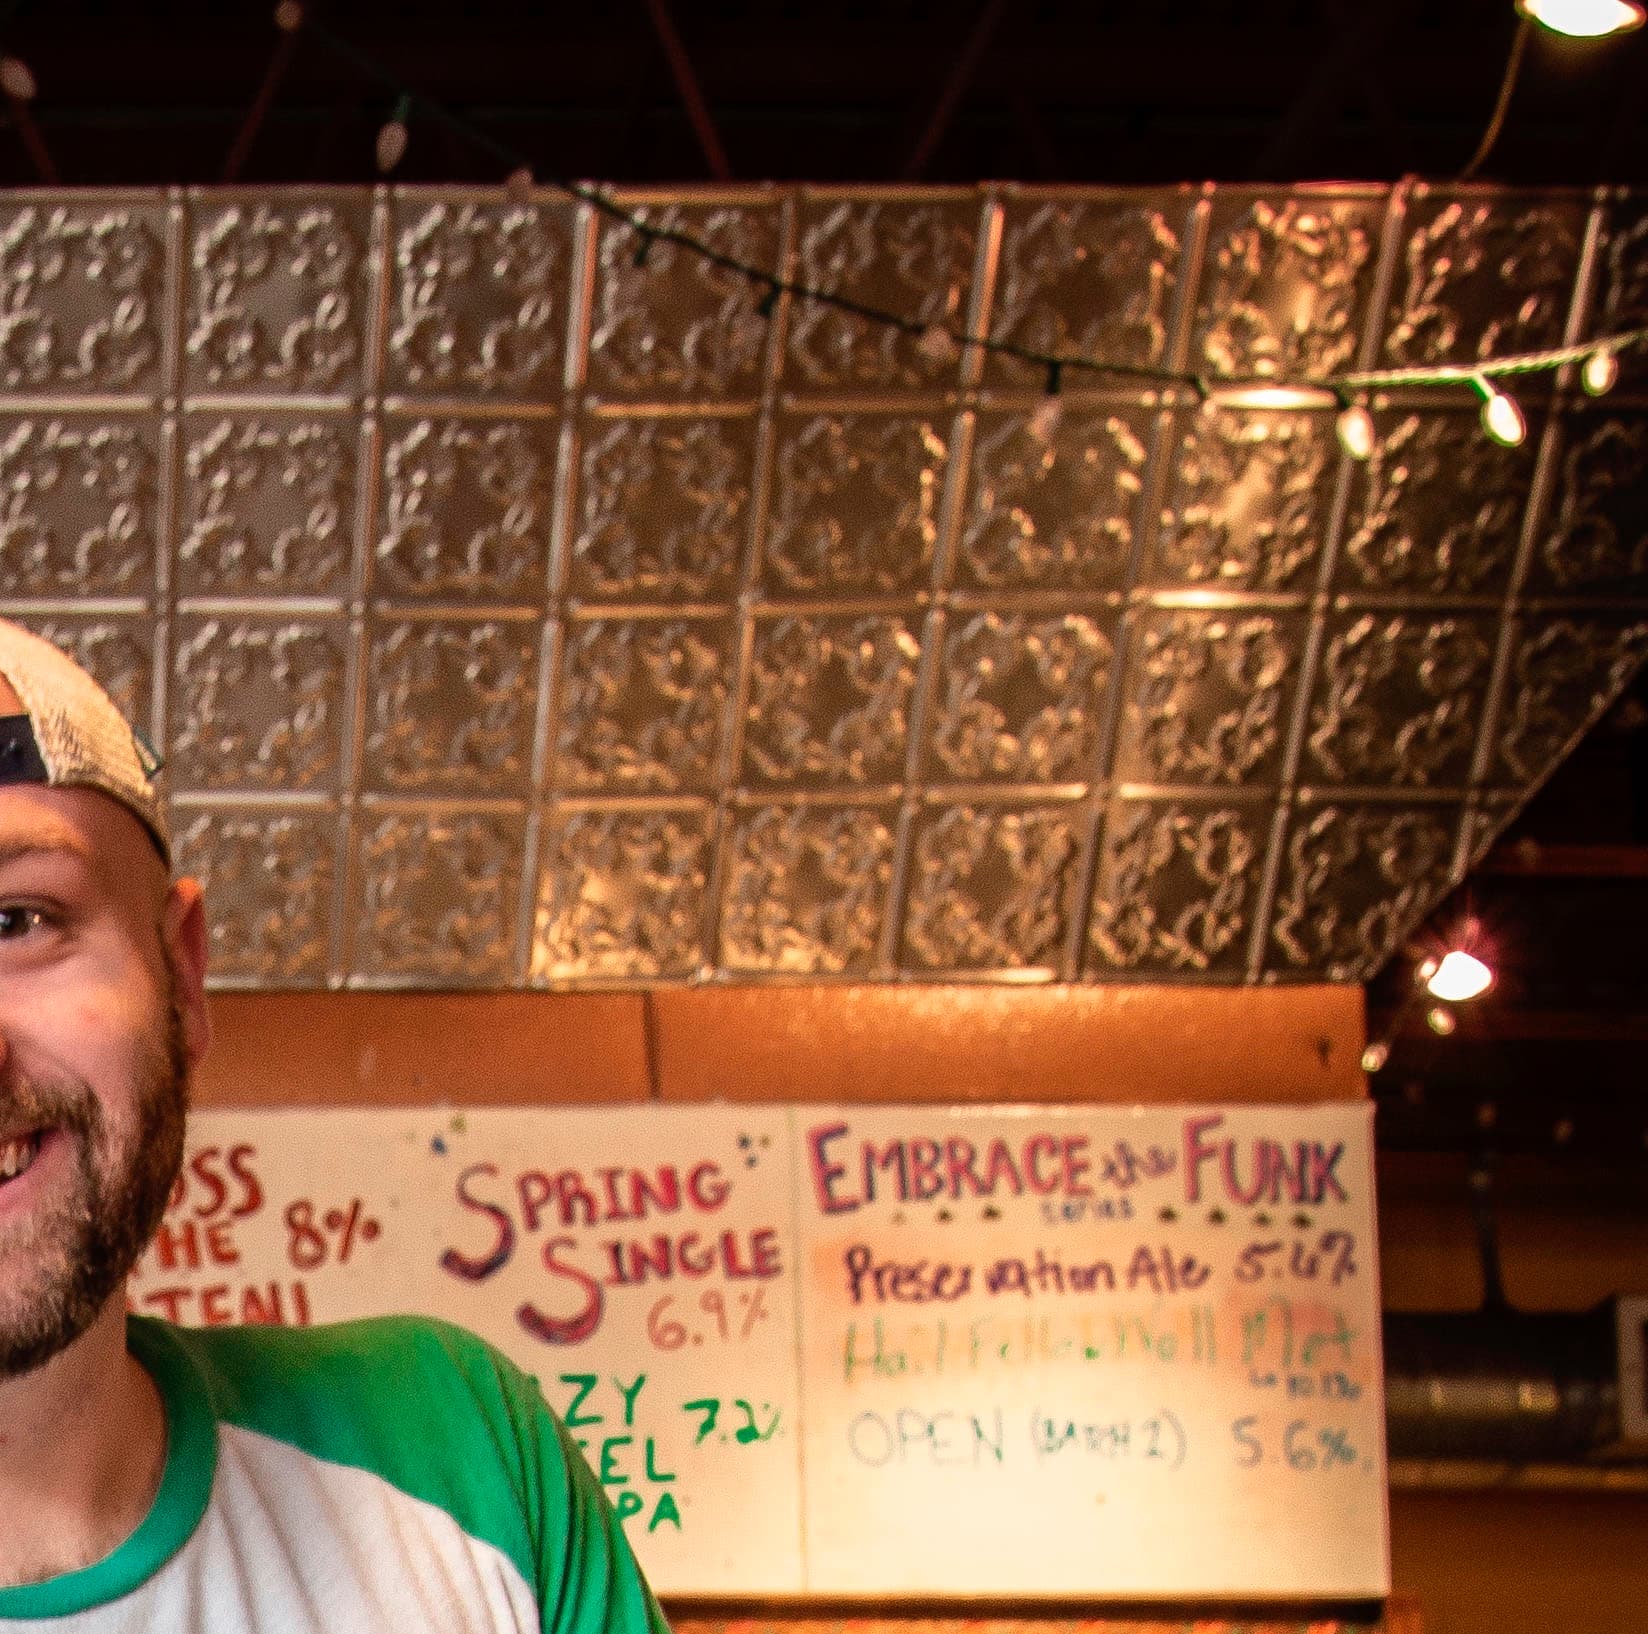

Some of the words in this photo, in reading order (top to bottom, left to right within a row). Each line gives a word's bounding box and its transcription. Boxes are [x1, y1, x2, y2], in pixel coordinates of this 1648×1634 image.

[807, 1119, 1094, 1216] EMBRACE
[1181, 1113, 1349, 1207] FUNK
[284, 1198, 382, 1272] 8%
[438, 1160, 730, 1285] SPRING
[516, 1227, 784, 1348] SINGLE
[1126, 1245, 1213, 1295] Ale
[648, 1287, 770, 1352] 6.9%
[848, 1409, 1003, 1469] OPEN
